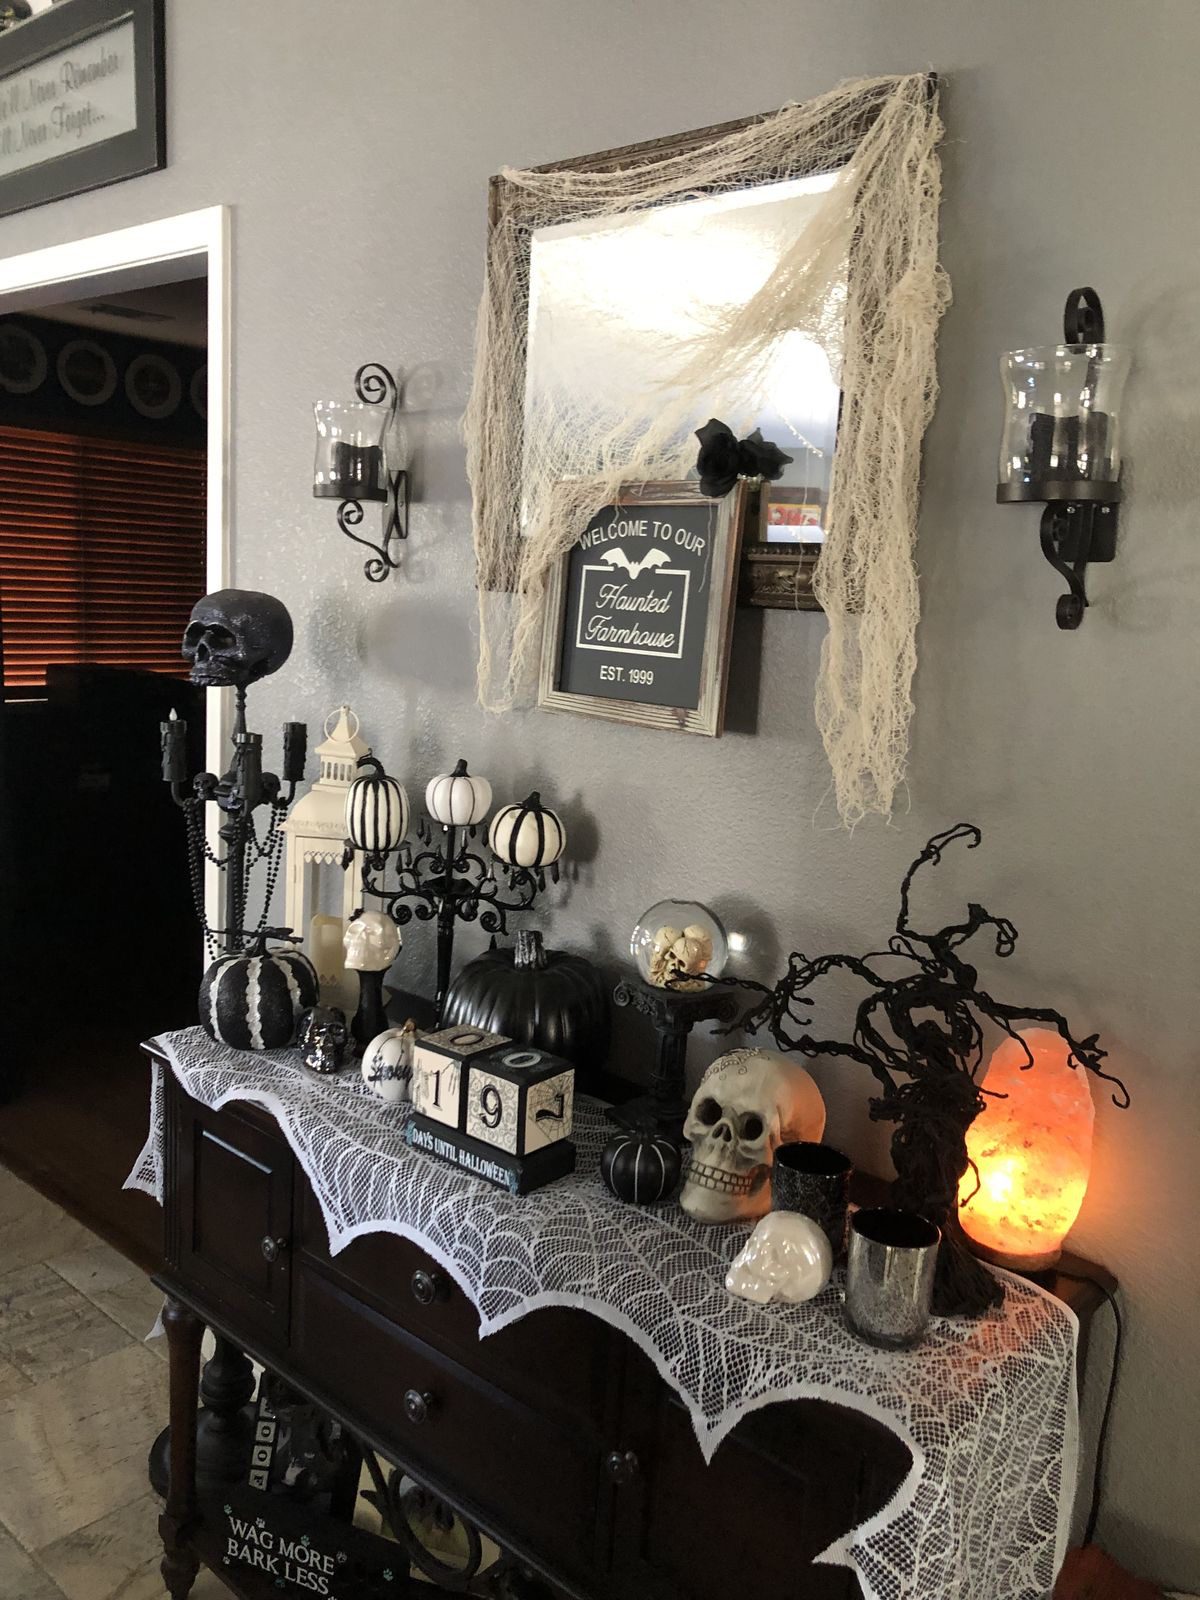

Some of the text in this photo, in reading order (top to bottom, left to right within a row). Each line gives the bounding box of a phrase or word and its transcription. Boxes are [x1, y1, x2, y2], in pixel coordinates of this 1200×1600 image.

[60, 47, 119, 93] Remember
[16, 121, 47, 153] Never
[579, 520, 706, 556] WELCOME TO OUR
[595, 583, 672, 614] Haunted
[585, 614, 675, 648] Farmhouse
[600, 665, 654, 685] EST. 1999
[430, 1069, 503, 1129] 1 9
[412, 1127, 512, 1186] DAYS UNTIL HALLOWEEN
[227, 1537, 329, 1596] BARK LESS
[228, 1516, 335, 1576] WAG MORE
